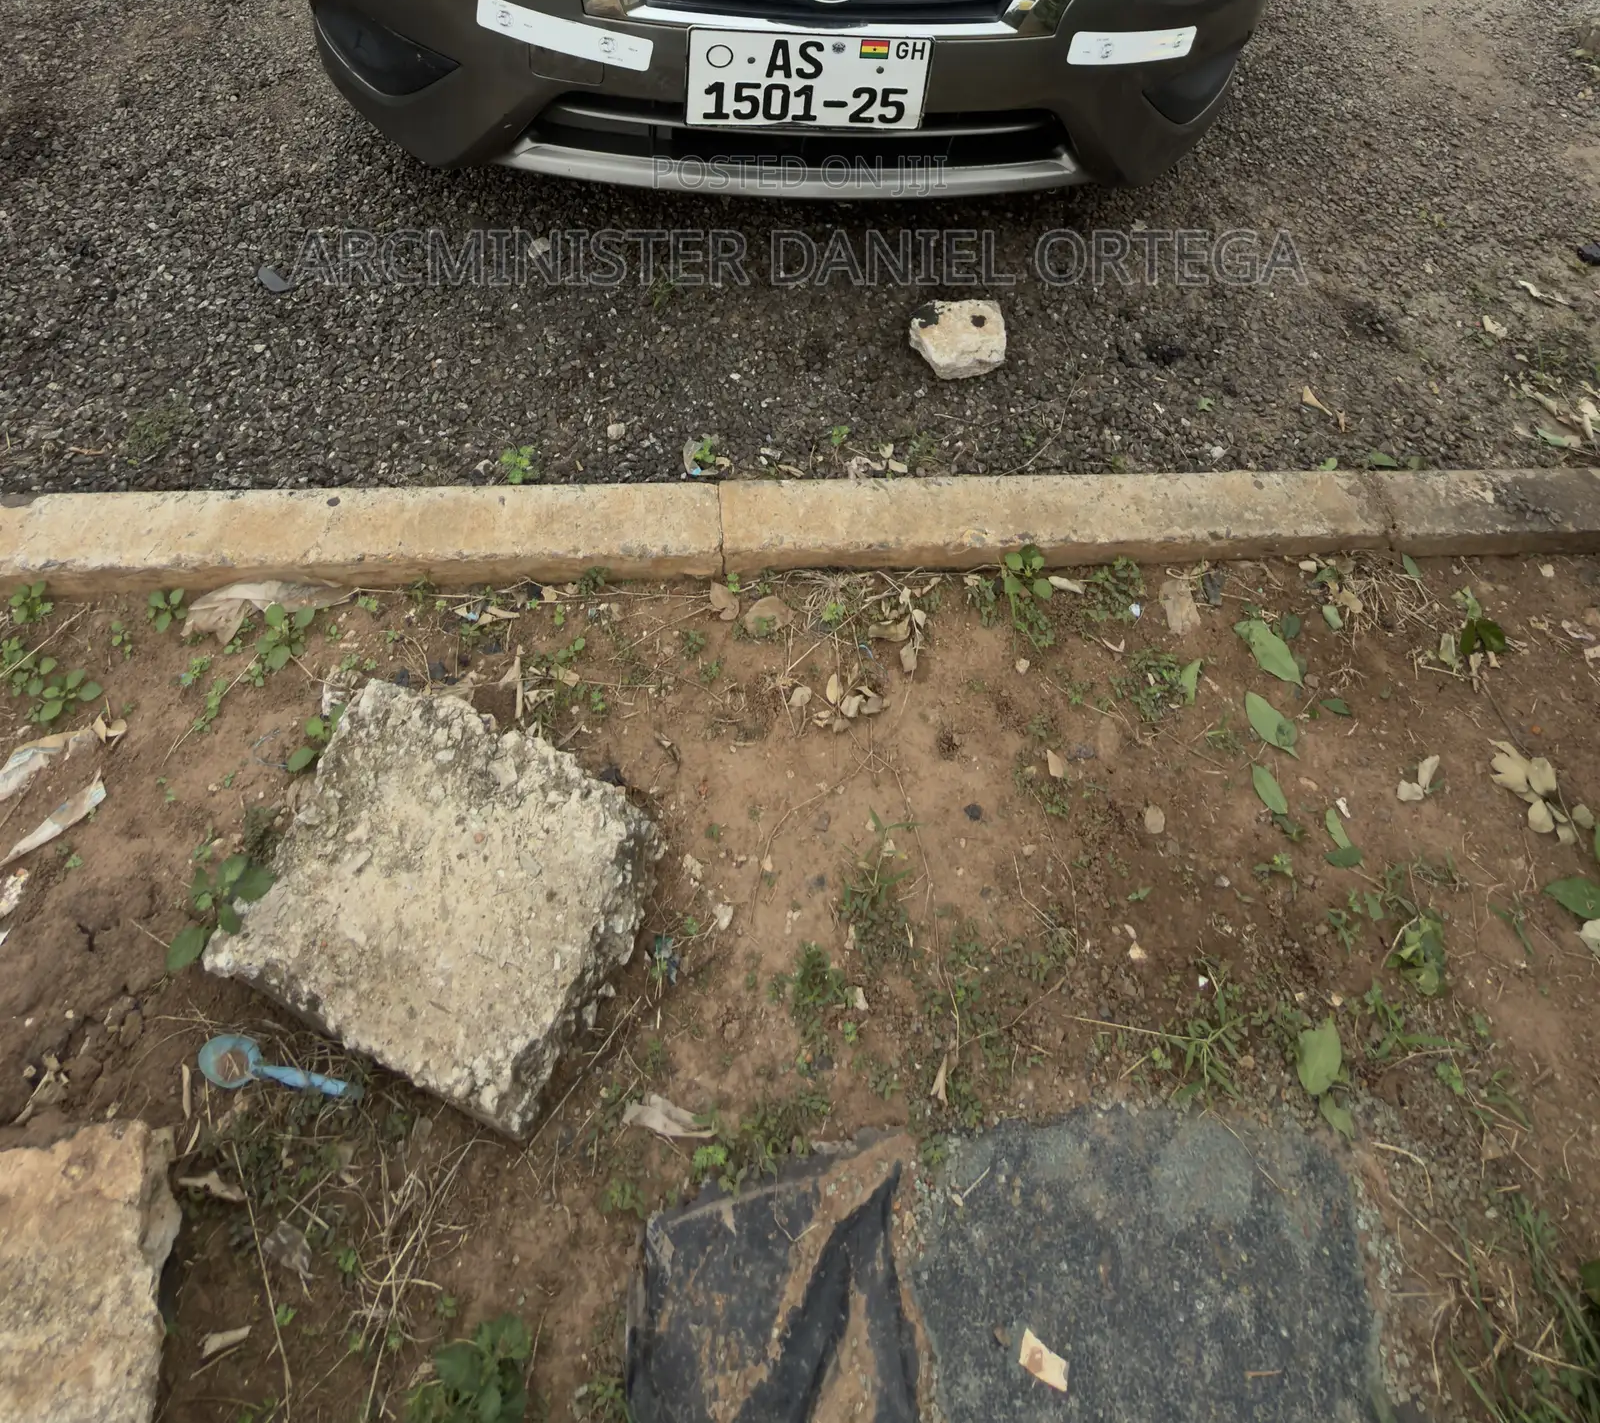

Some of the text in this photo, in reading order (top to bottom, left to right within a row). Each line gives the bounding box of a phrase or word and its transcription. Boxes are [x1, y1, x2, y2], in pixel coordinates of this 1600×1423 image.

[765, 38, 926, 80] AS GH
[702, 81, 909, 124] 1501-25
